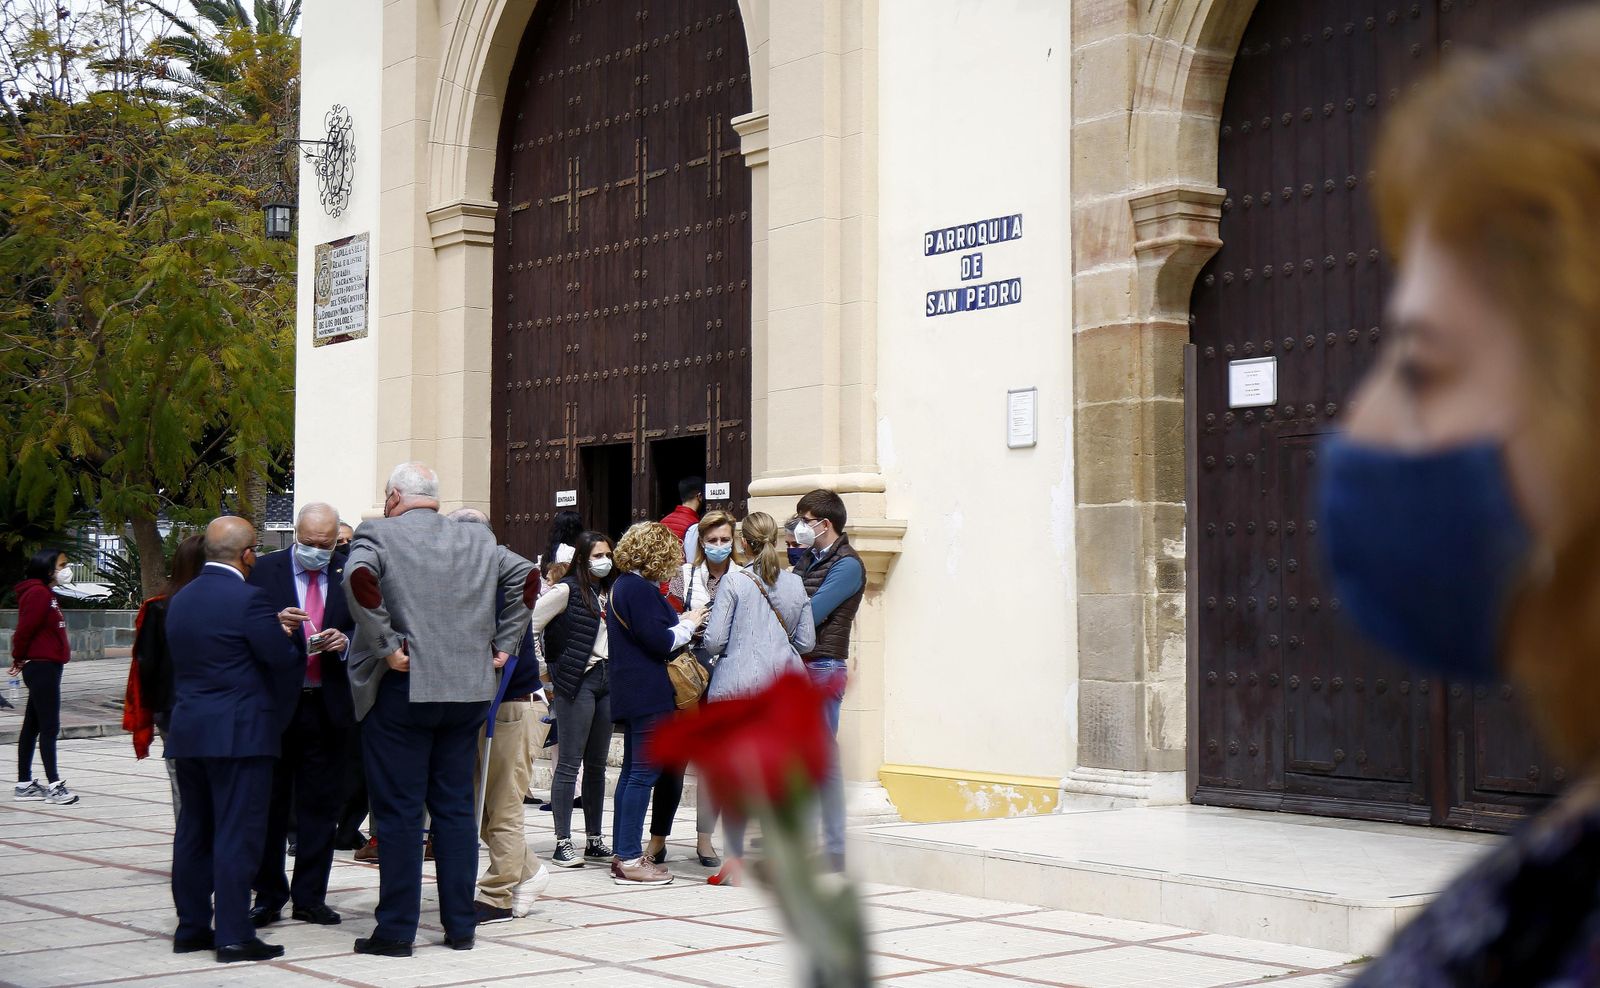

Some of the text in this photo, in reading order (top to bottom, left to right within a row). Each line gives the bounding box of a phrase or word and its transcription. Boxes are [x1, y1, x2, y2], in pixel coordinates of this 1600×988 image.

[925, 216, 1022, 254] PARROQUIA
[336, 275, 364, 287] SACRAMENTAL
[962, 255, 981, 278] DE
[926, 280, 1021, 315] SAN PEDRO
